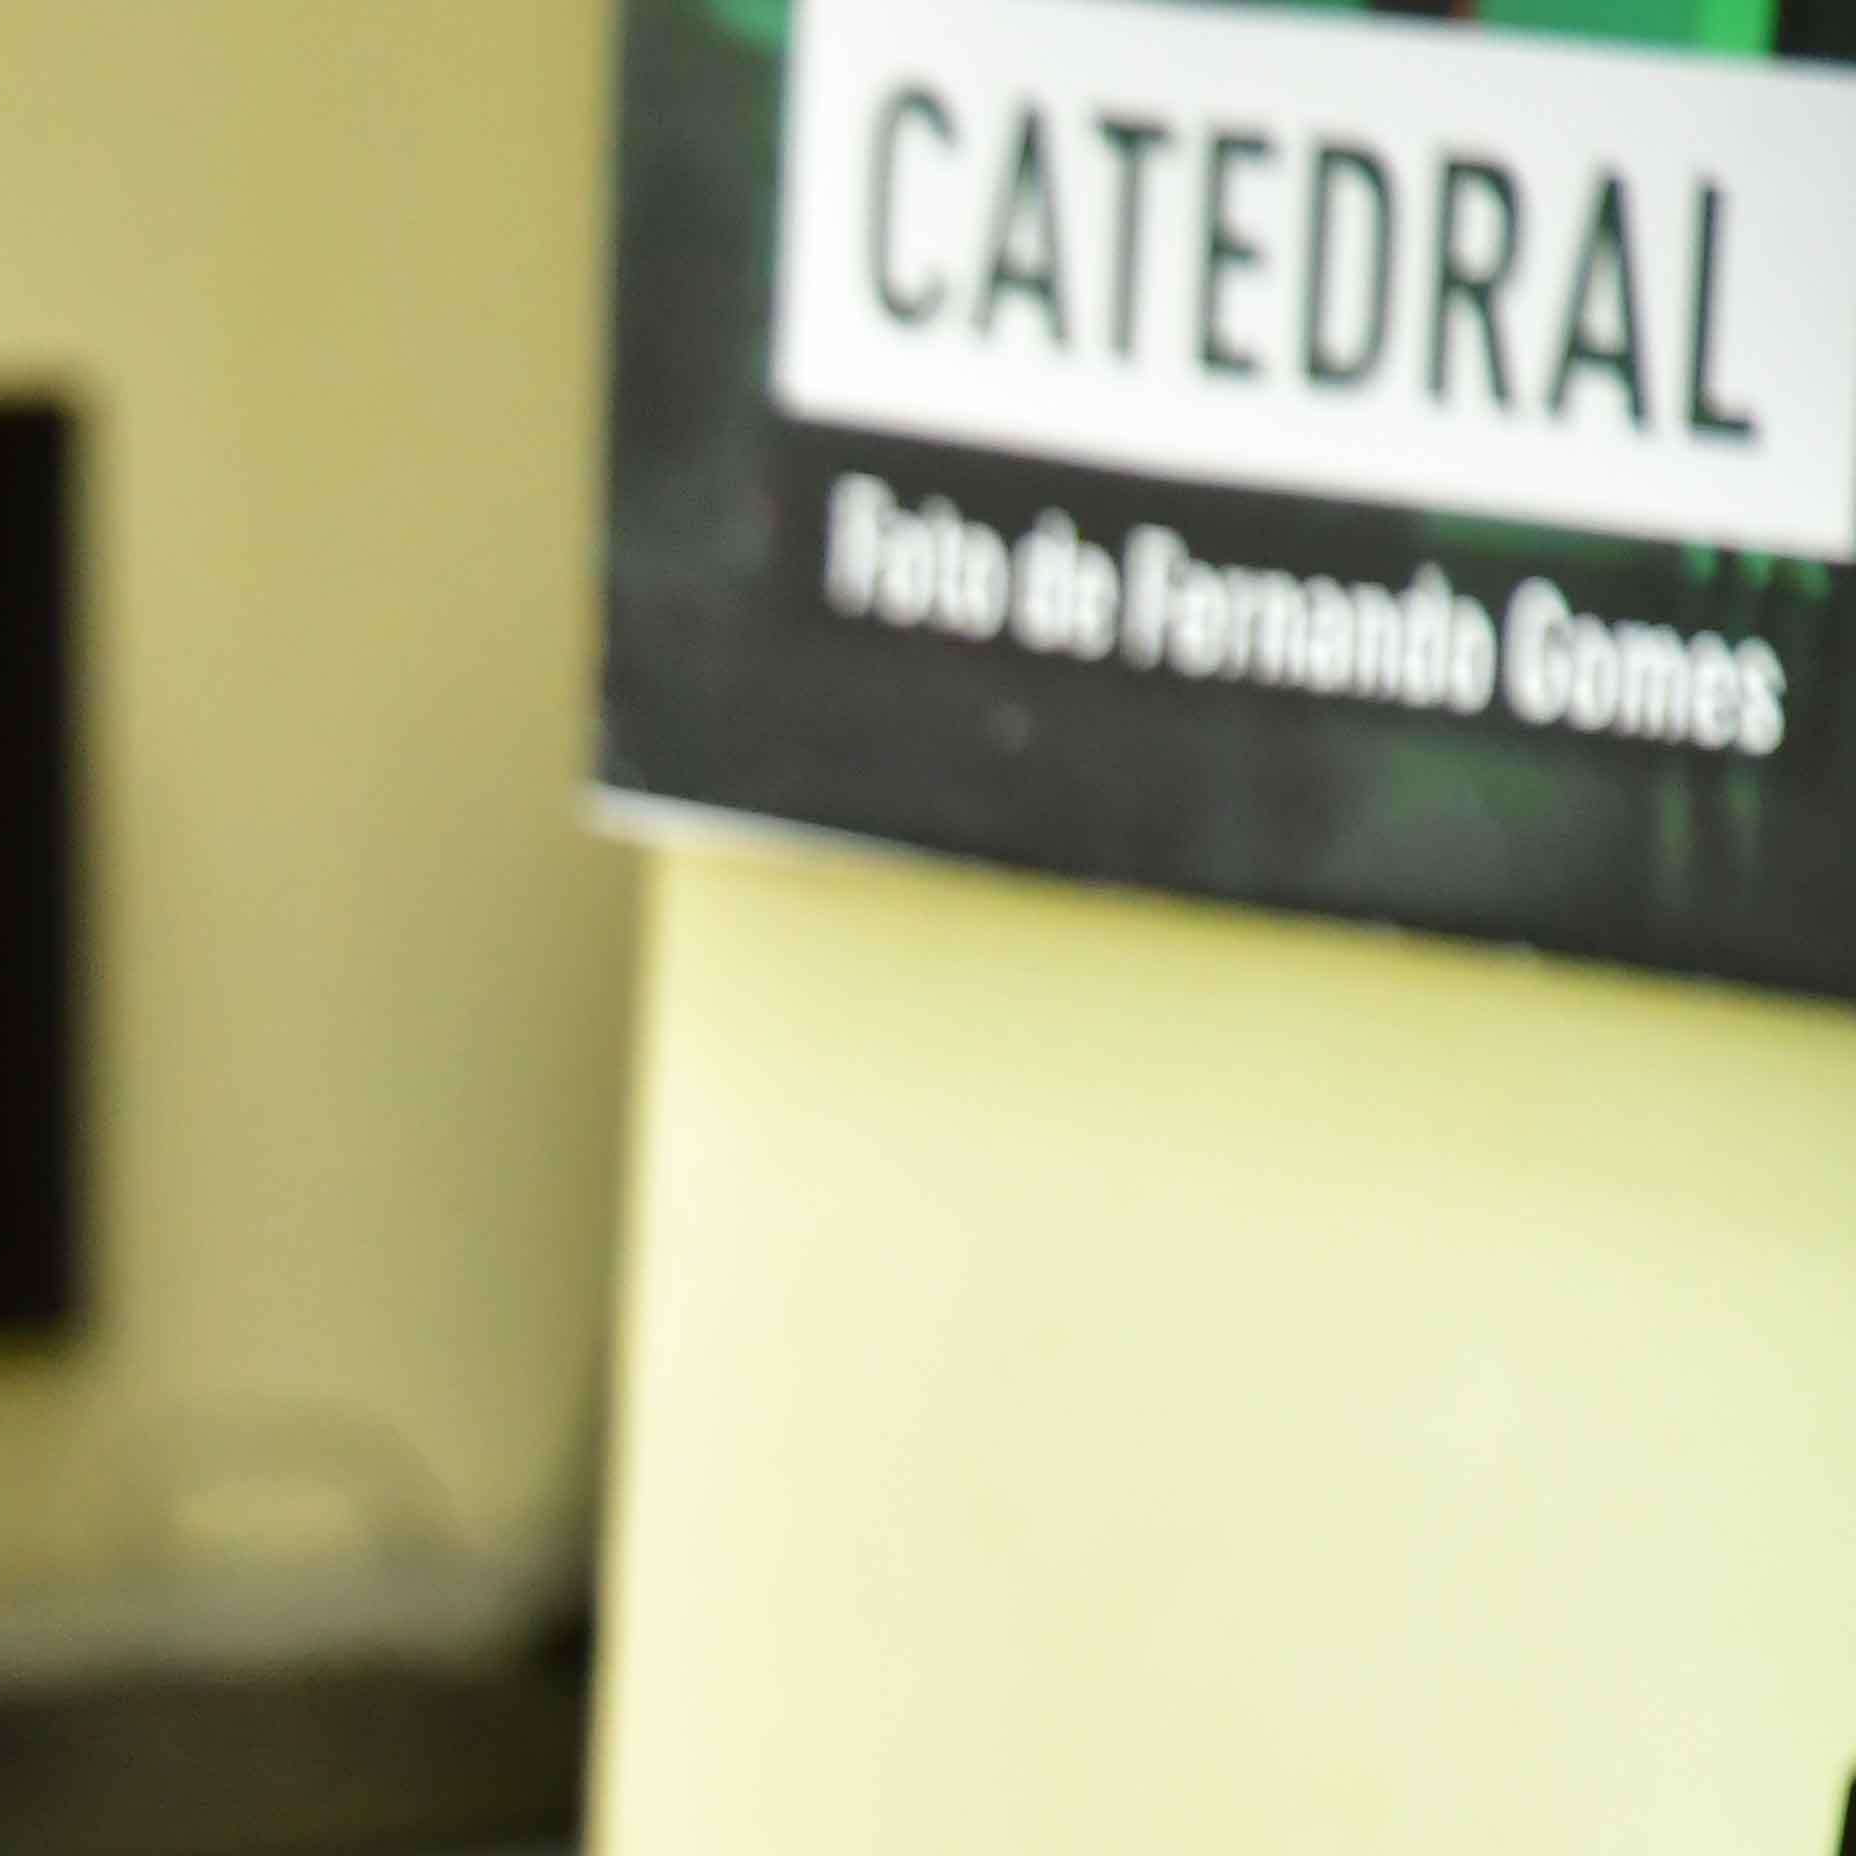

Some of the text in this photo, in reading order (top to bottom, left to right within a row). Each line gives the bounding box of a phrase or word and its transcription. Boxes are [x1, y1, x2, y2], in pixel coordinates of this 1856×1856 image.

[870, 80, 1761, 446] CATEDRAL
[825, 470, 1788, 755] Foto de Fernando Gomes
